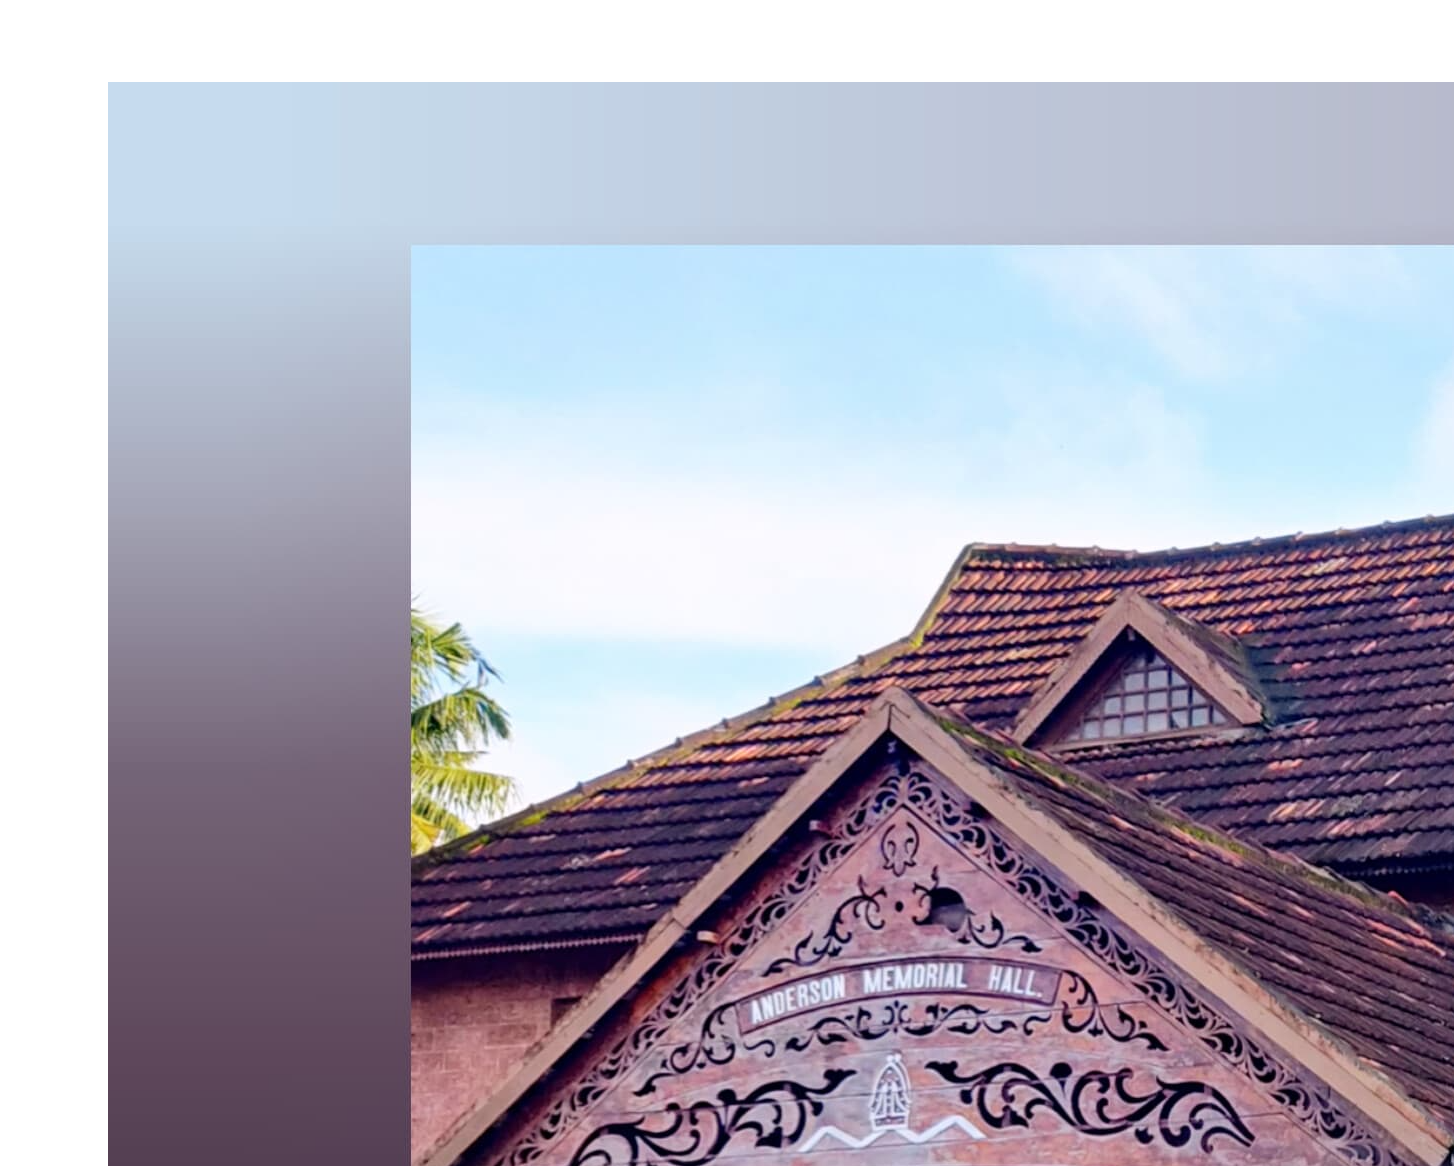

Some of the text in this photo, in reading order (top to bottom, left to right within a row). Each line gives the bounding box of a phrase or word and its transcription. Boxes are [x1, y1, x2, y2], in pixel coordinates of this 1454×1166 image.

[751, 962, 1042, 1025] ANDERSON MEMORIAL HALL.
